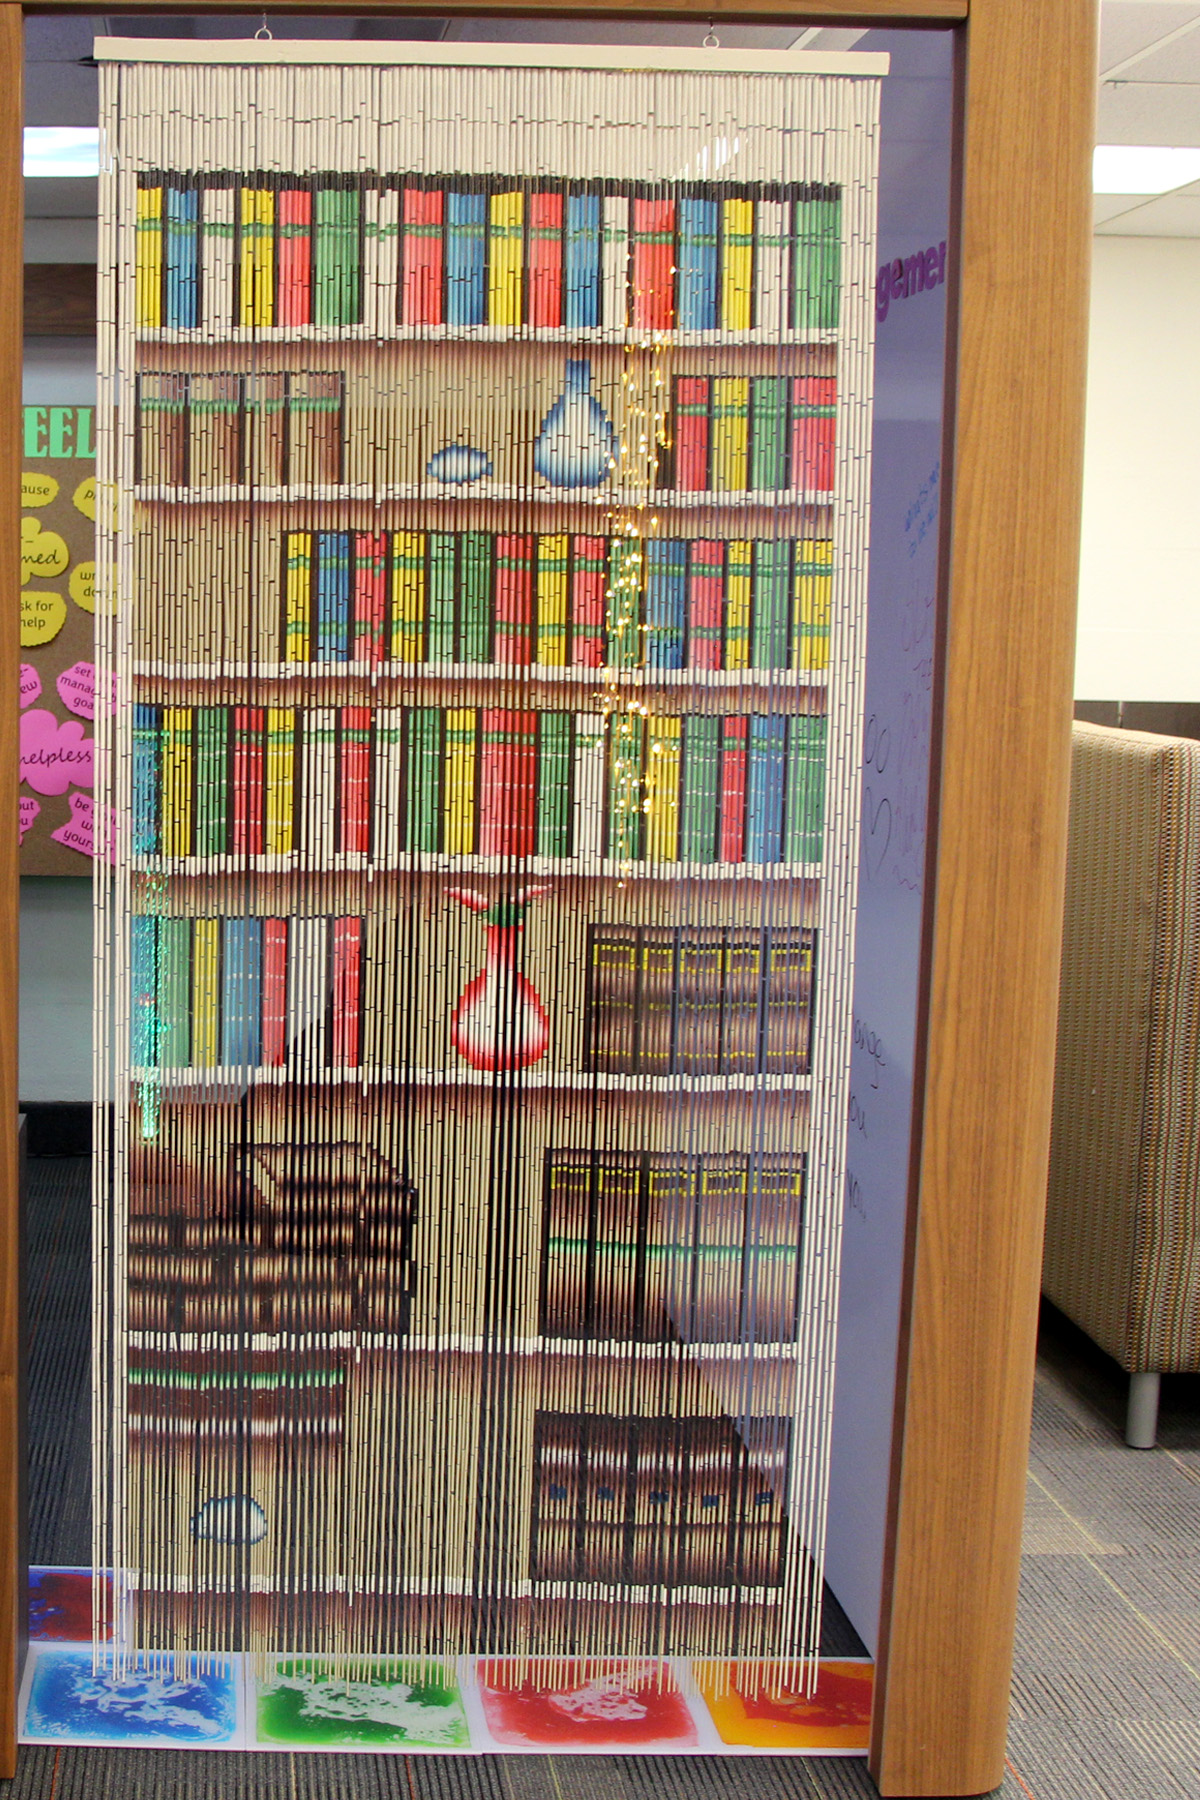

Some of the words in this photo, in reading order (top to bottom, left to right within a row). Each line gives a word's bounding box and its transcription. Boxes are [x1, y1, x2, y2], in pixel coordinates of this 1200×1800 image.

[22, 407, 96, 458] EEL
[22, 484, 50, 495] ause
[36, 600, 53, 611] for
[74, 666, 91, 677] set
[74, 798, 89, 812] be
